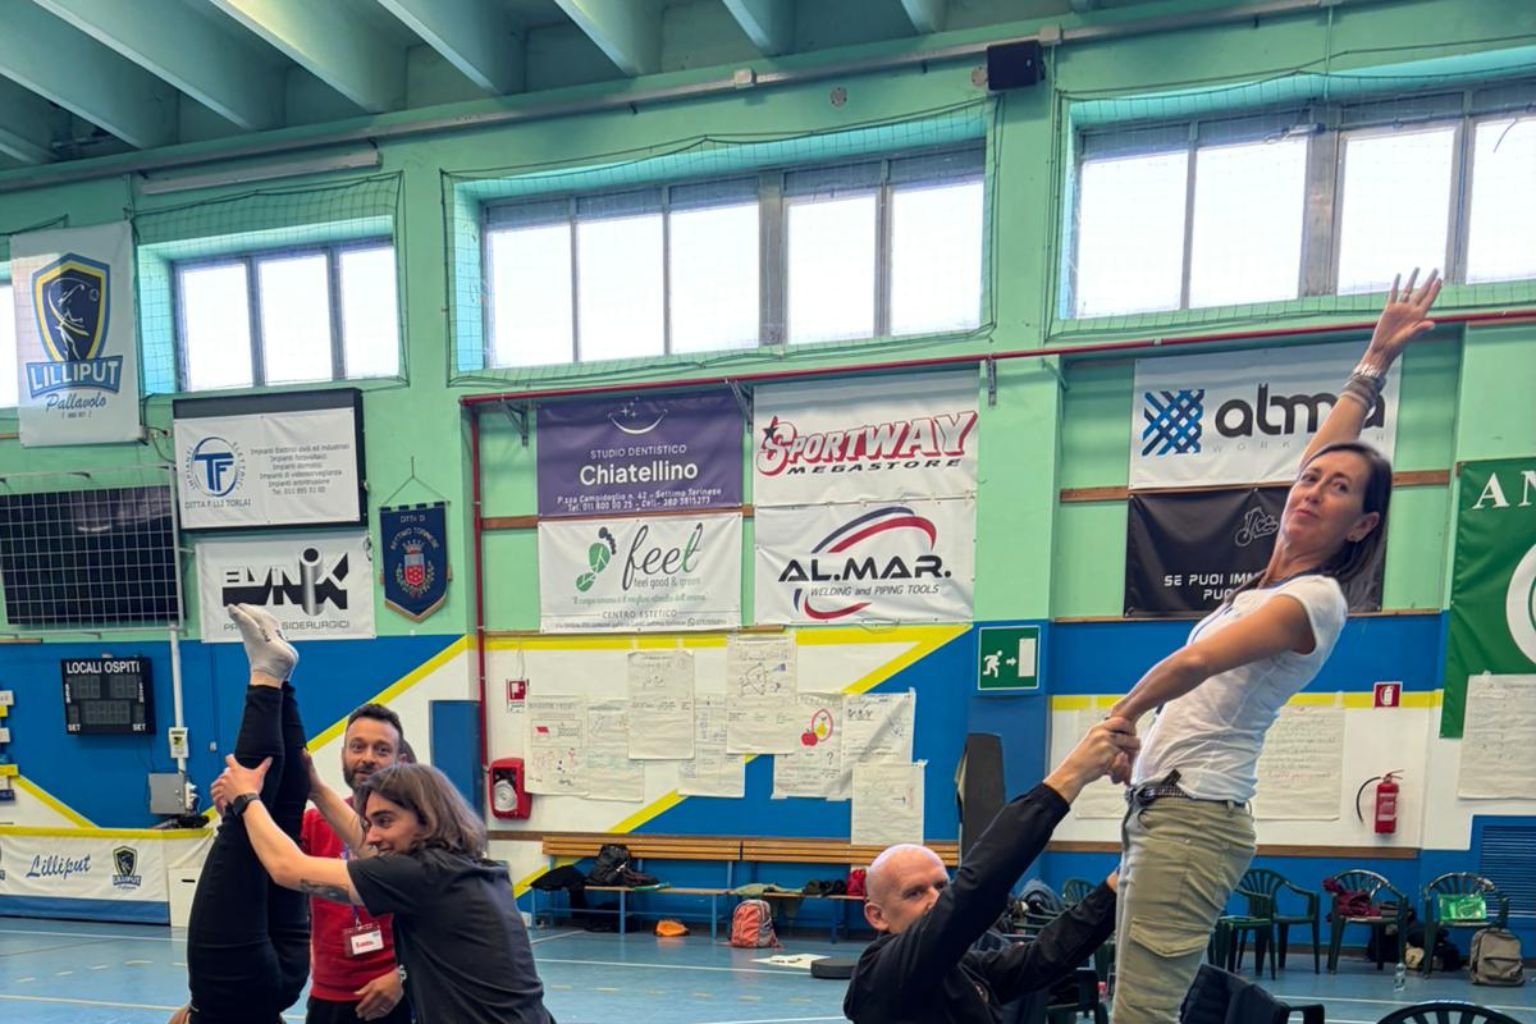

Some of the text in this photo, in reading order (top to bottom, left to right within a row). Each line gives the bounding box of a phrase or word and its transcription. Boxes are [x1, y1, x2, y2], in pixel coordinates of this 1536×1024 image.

[30, 361, 118, 390] LILLIPUT
[590, 444, 687, 459] STUDIO DENTISTICO
[757, 411, 978, 476] SPORTWAY
[580, 461, 698, 486] Chiatellino
[787, 459, 961, 475] MEGASTORE
[778, 555, 951, 582] AL.MAR.
[1164, 575, 1182, 587] SE
[1189, 573, 1223, 586] PUOI
[811, 584, 939, 597] WELDING and PIPING TOOLS
[602, 610, 635, 619] CENTRO
[66, 661, 140, 674] LOCALI OSPITI
[26, 854, 91, 879] Lilliput
